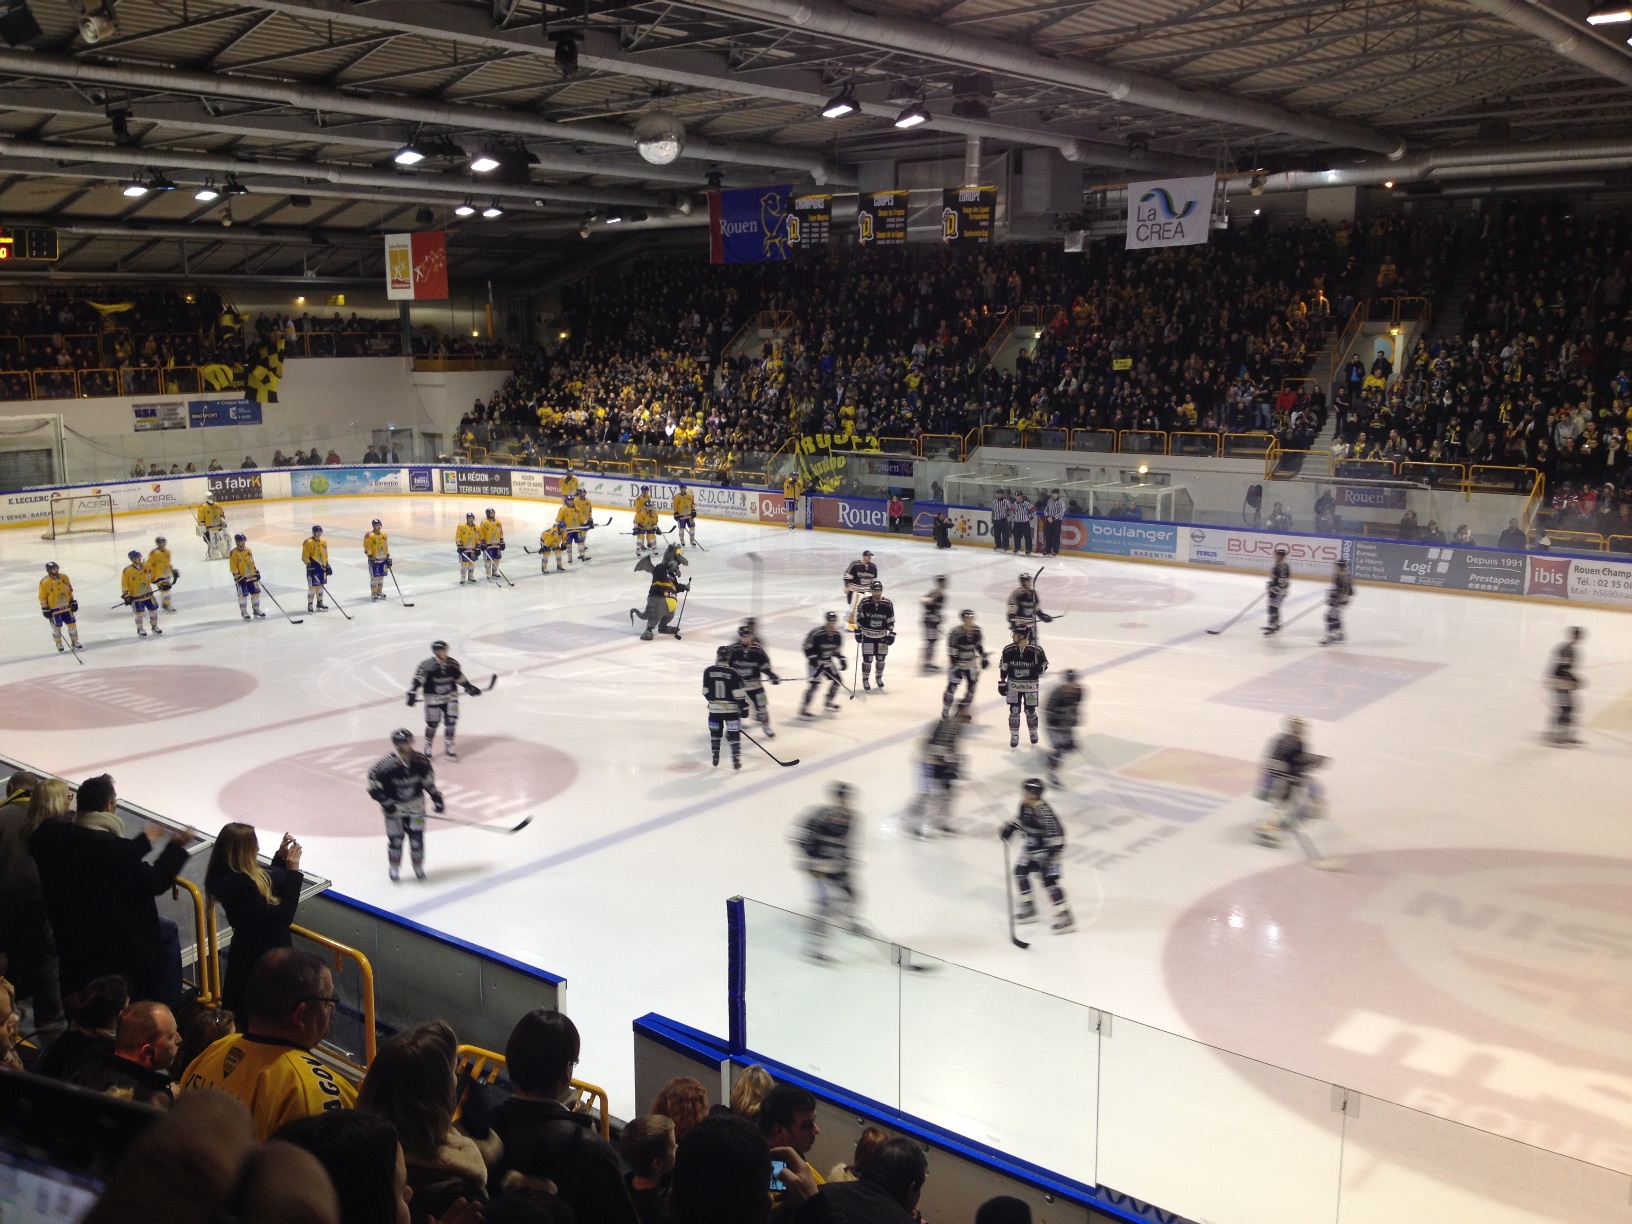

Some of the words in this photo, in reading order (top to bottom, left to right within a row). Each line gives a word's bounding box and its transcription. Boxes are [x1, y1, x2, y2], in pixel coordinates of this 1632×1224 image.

[1137, 205, 1157, 222] La
[719, 219, 758, 237] Rouen
[1136, 221, 1185, 242] CREA
[874, 462, 899, 473] Rouen
[208, 479, 223, 490] La
[225, 476, 262, 489] fabrK
[458, 472, 467, 482] LA
[467, 470, 489, 482] RÉGION
[459, 485, 481, 494] TERRAIN
[490, 486, 510, 495] SPORTS
[630, 483, 678, 500] DILLY
[1345, 489, 1384, 504] Rouen
[8, 495, 49, 505] E.LECLERC
[78, 499, 119, 510] ACEREL
[137, 493, 177, 504] ACEREL
[762, 499, 787, 518] Quic
[1092, 523, 1174, 543] boulanger
[1133, 549, 1173, 559] BARENTIN
[1227, 537, 1338, 561] BUROSYS
[1402, 559, 1433, 575] Logi
[1466, 555, 1498, 566] Depuis
[1501, 558, 1523, 568] 1991
[1534, 567, 1564, 585] ibis
[1574, 564, 1600, 576] Rouen
[1602, 567, 1632, 579] Champ
[1469, 573, 1521, 586] Prestapose
[1597, 579, 1608, 587] 02
[1610, 580, 1621, 588] 35
